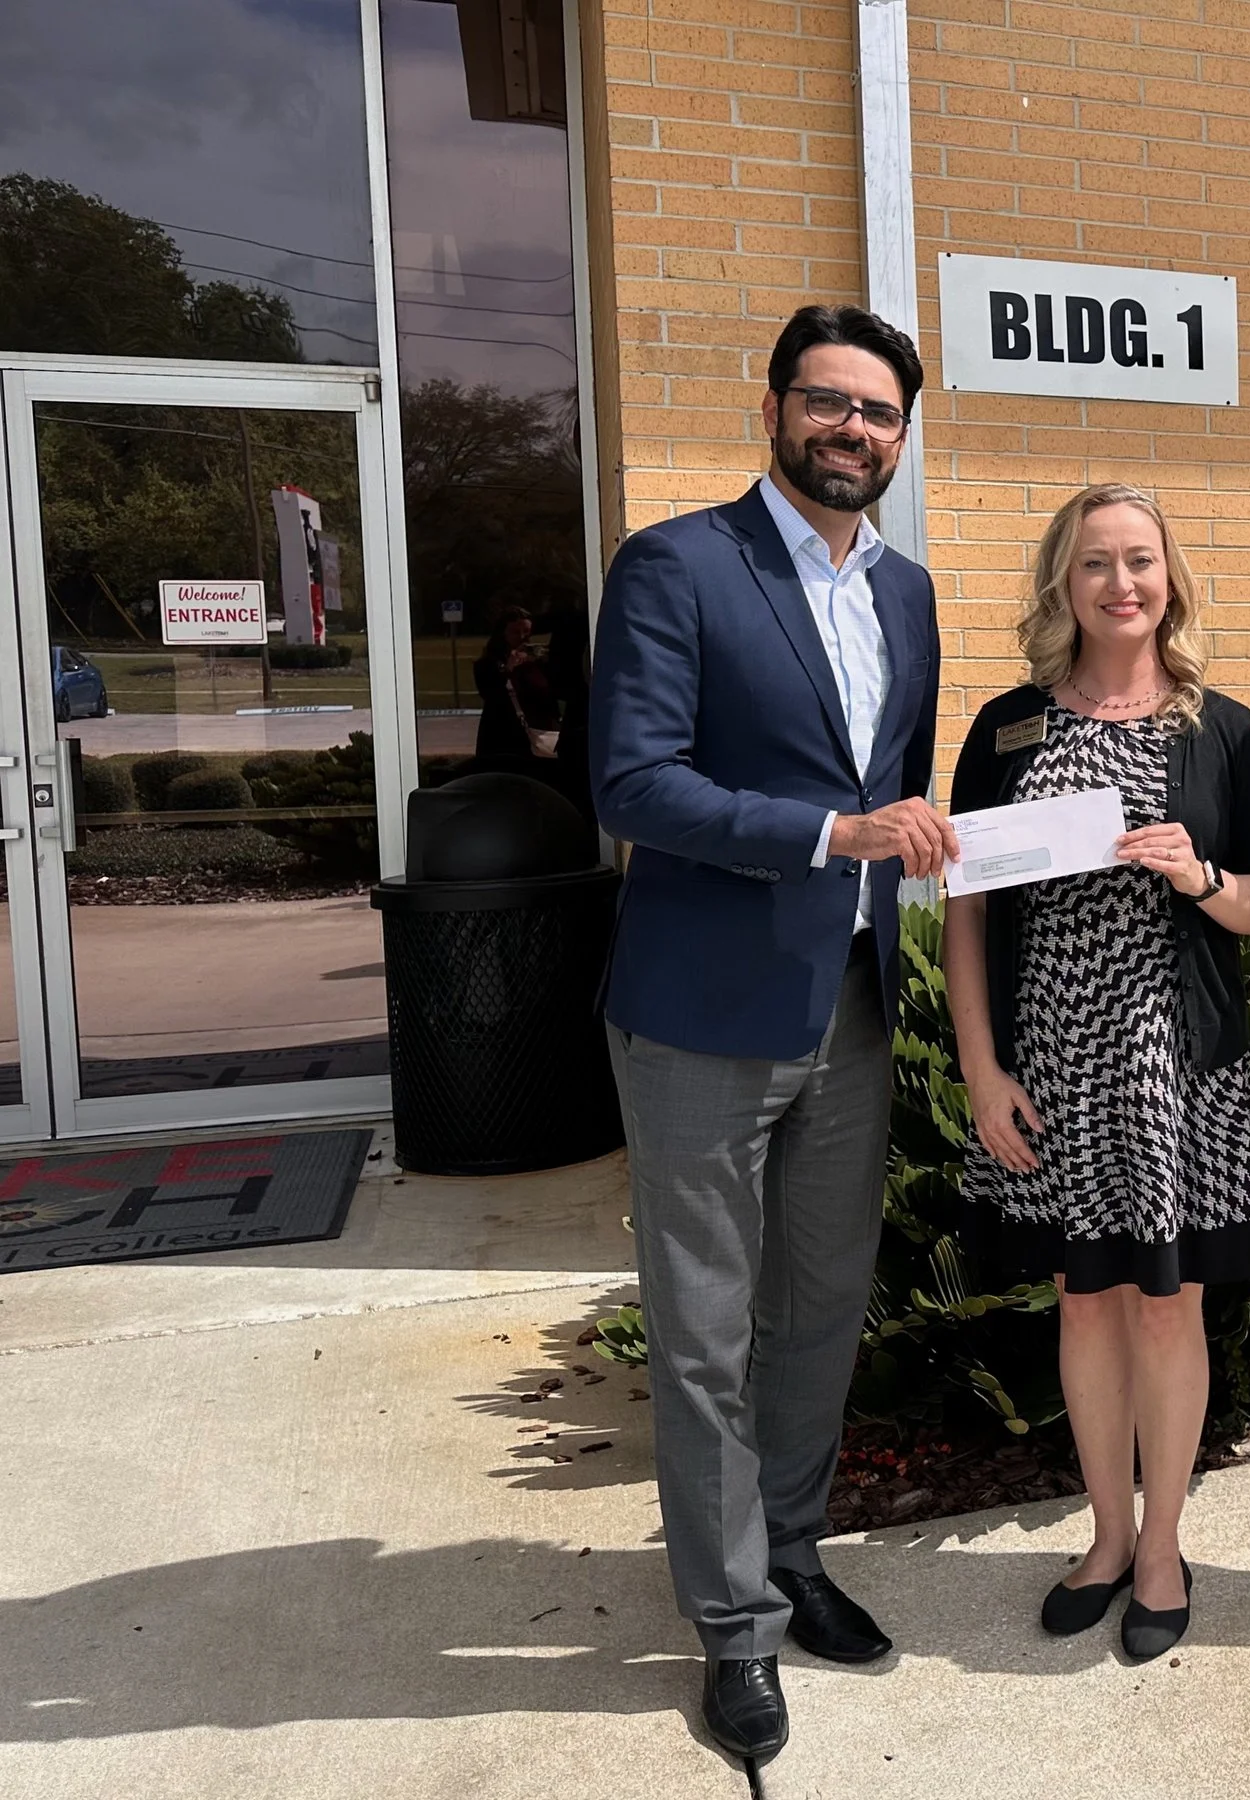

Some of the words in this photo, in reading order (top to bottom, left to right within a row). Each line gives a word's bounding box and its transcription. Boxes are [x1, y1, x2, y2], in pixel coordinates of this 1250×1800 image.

[988, 291, 1164, 368] BLDG.
[1176, 304, 1204, 370] 1
[178, 586, 246, 602] Welcome!
[168, 608, 259, 623] ENTRANCE
[46, 1224, 281, 1259] College
